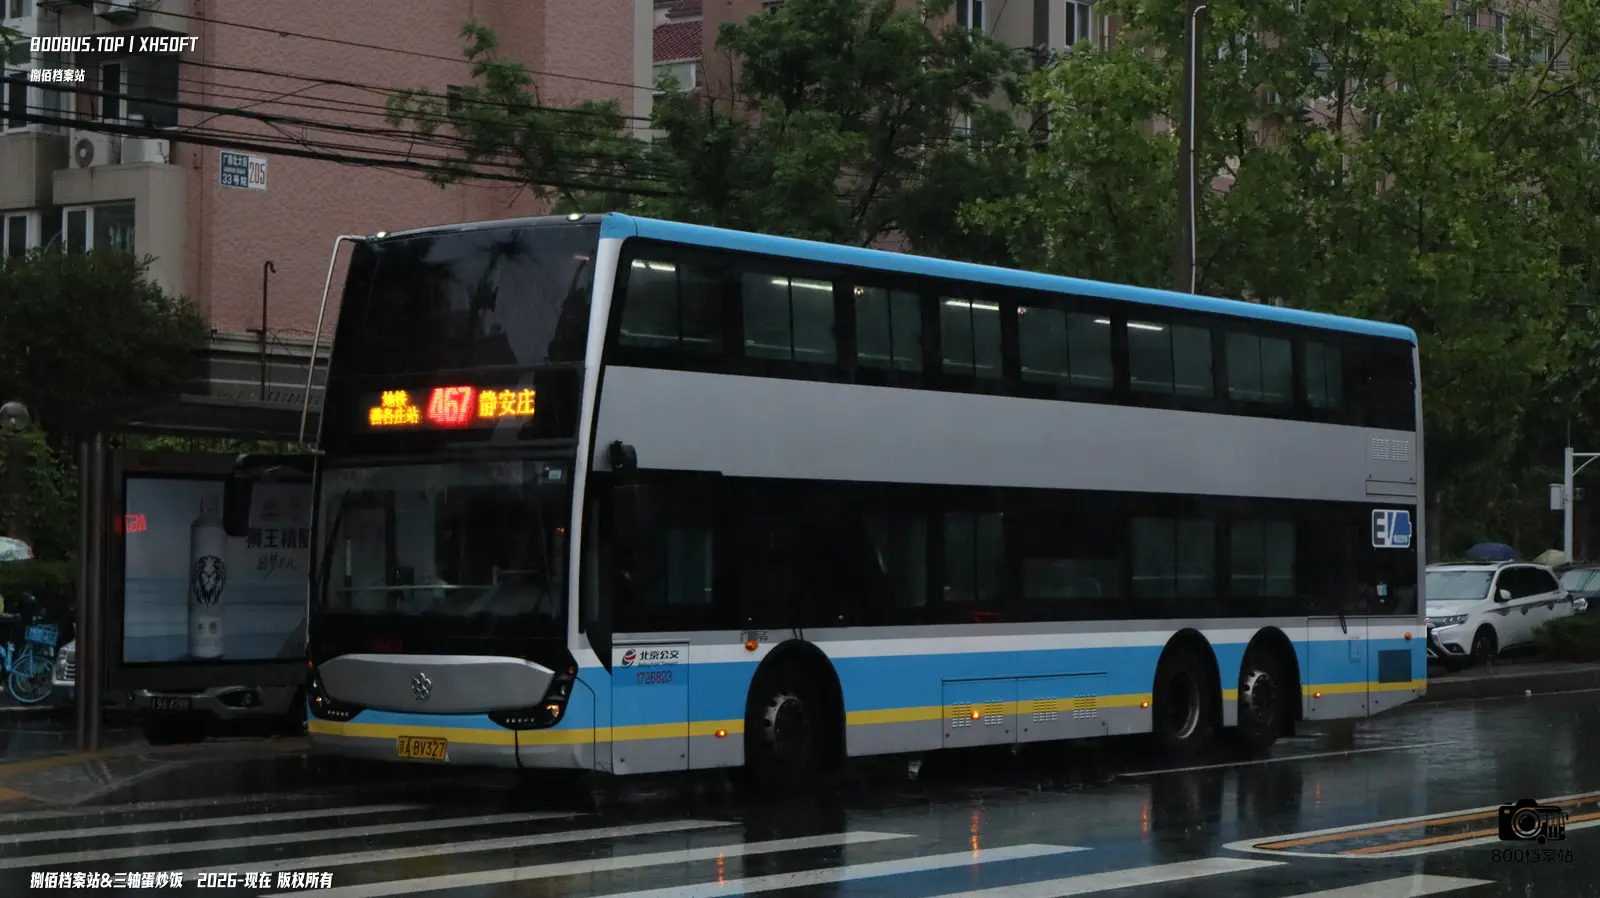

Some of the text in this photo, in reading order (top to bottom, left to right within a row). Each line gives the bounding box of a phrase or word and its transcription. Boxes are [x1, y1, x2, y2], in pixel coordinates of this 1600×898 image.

[250, 162, 266, 185] 205
[429, 386, 472, 423] 467
[478, 388, 536, 417] 静安庄
[639, 650, 680, 661] 北京公交
[636, 670, 674, 685] 1726823
